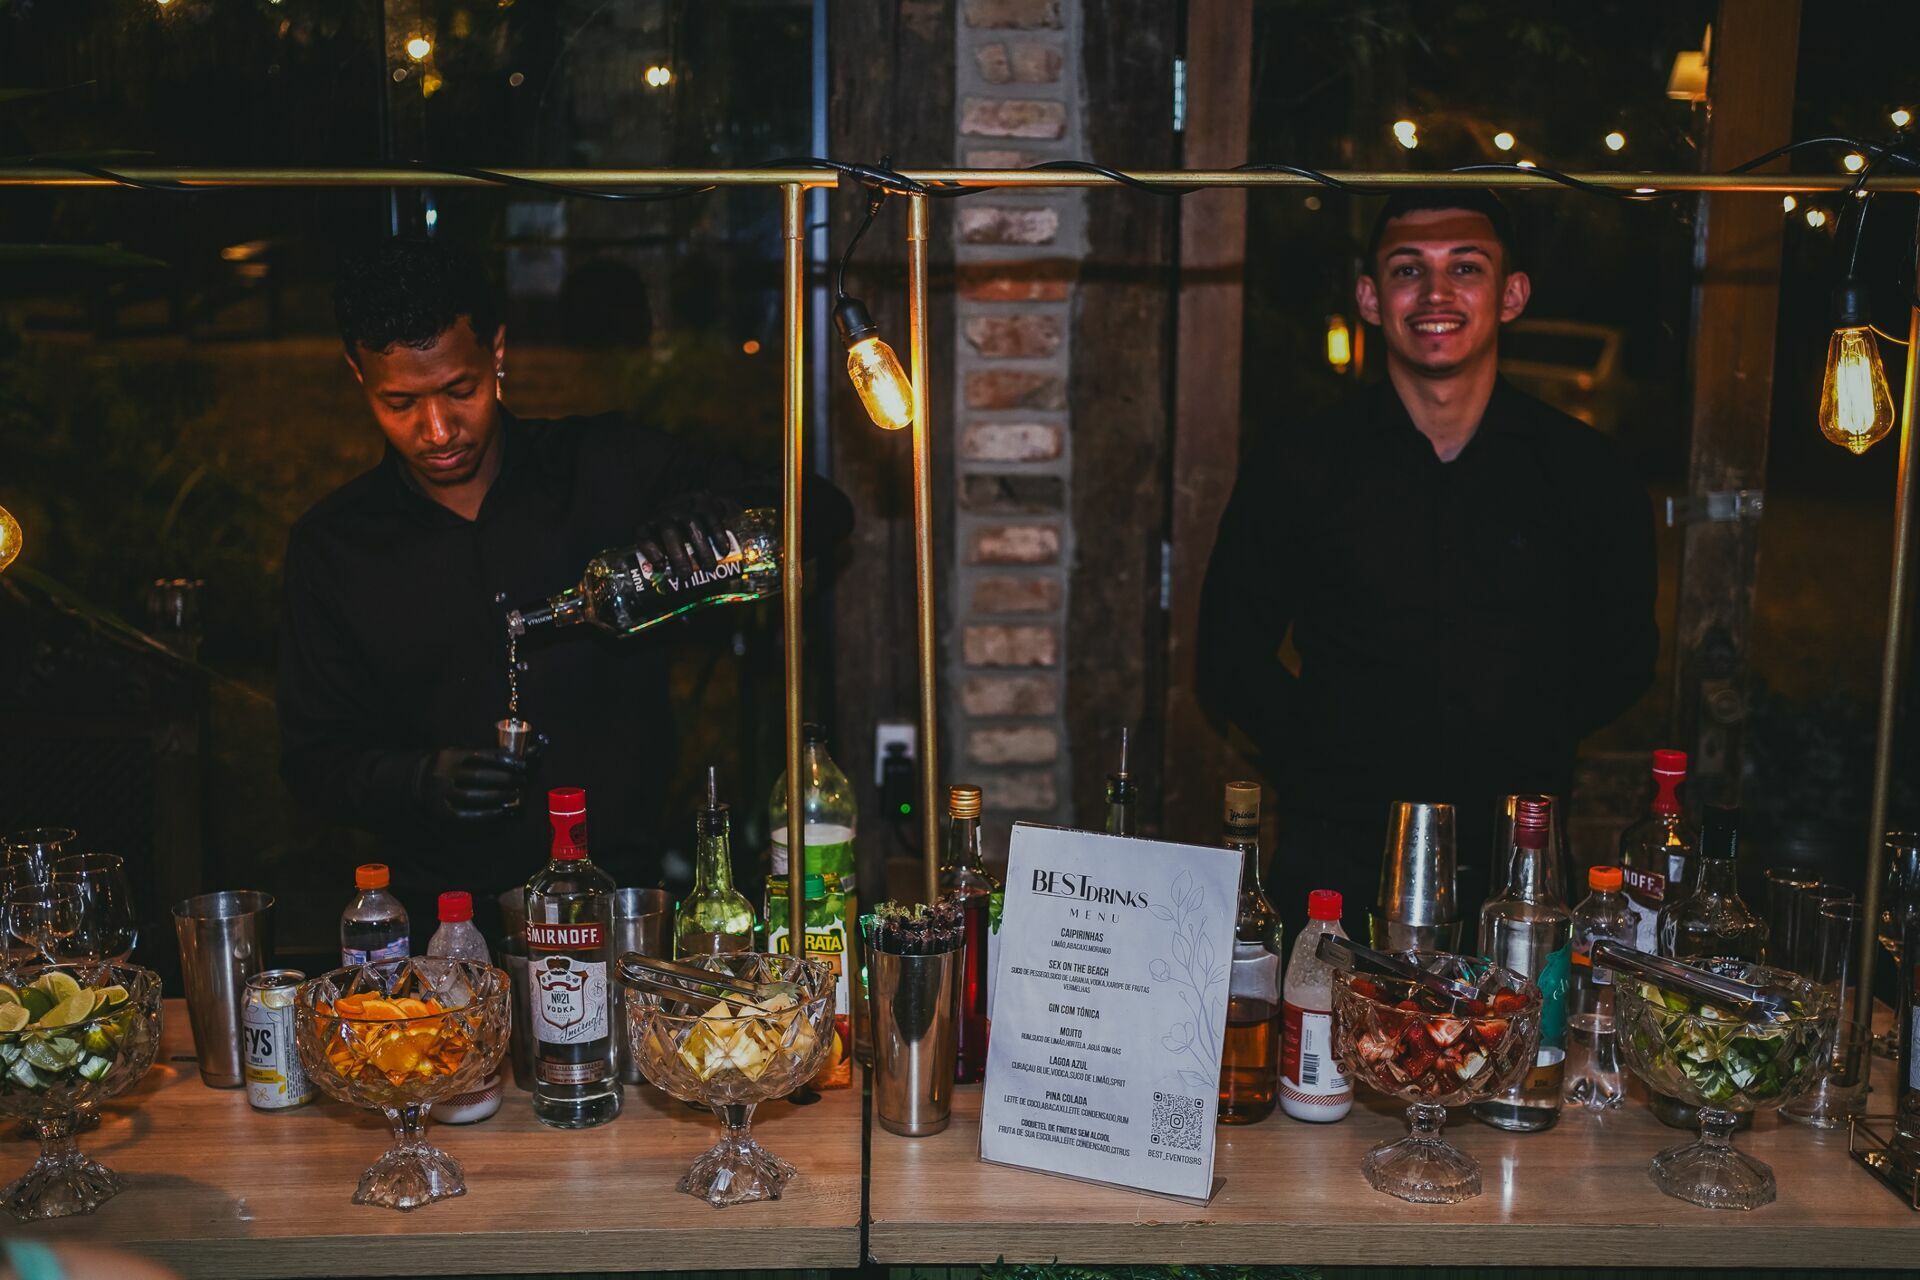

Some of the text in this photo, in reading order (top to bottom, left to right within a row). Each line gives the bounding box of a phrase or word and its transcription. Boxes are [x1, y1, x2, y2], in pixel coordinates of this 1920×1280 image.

[630, 568, 645, 592] RUM
[1069, 907, 1120, 924] MENU
[526, 926, 600, 945] SMIRNOFF
[1060, 927, 1104, 943] CAIPIRINHAS
[780, 935, 842, 953] MRATA
[1048, 959, 1109, 977] SEX ON THE BEACH
[1023, 968, 1030, 976] DE
[1062, 974, 1069, 982] DE
[1125, 983, 1131, 991] DE
[1131, 984, 1150, 994] FRUTAS
[1063, 983, 1091, 994] VERMELHAS
[546, 1004, 576, 1014] VODKA
[1048, 1002, 1100, 1020] GIN COM TÔNICA
[1060, 1026, 1082, 1039] MOJITO
[244, 1026, 273, 1058] FYS
[1044, 1036, 1050, 1044] DE
[1100, 1045, 1112, 1054] COM
[1112, 1047, 1122, 1056] GAS
[1049, 1055, 1088, 1070] LAGOA AZUL
[1011, 1061, 1036, 1072] CURAÇAU
[1084, 1074, 1092, 1082] DE
[1004, 1094, 1019, 1104] LEITE
[1019, 1097, 1026, 1105] DE
[1045, 1090, 1088, 1106] PINA COLADA
[998, 1125, 1016, 1135] FRUTA
[1016, 1127, 1024, 1137] DE
[1024, 1129, 1036, 1139] SUA
[1020, 1118, 1110, 1142] COQUETEL DE FRUTAS SEM ALCOOL
[1147, 1149, 1202, 1166] BEST_EVENTOSRS
